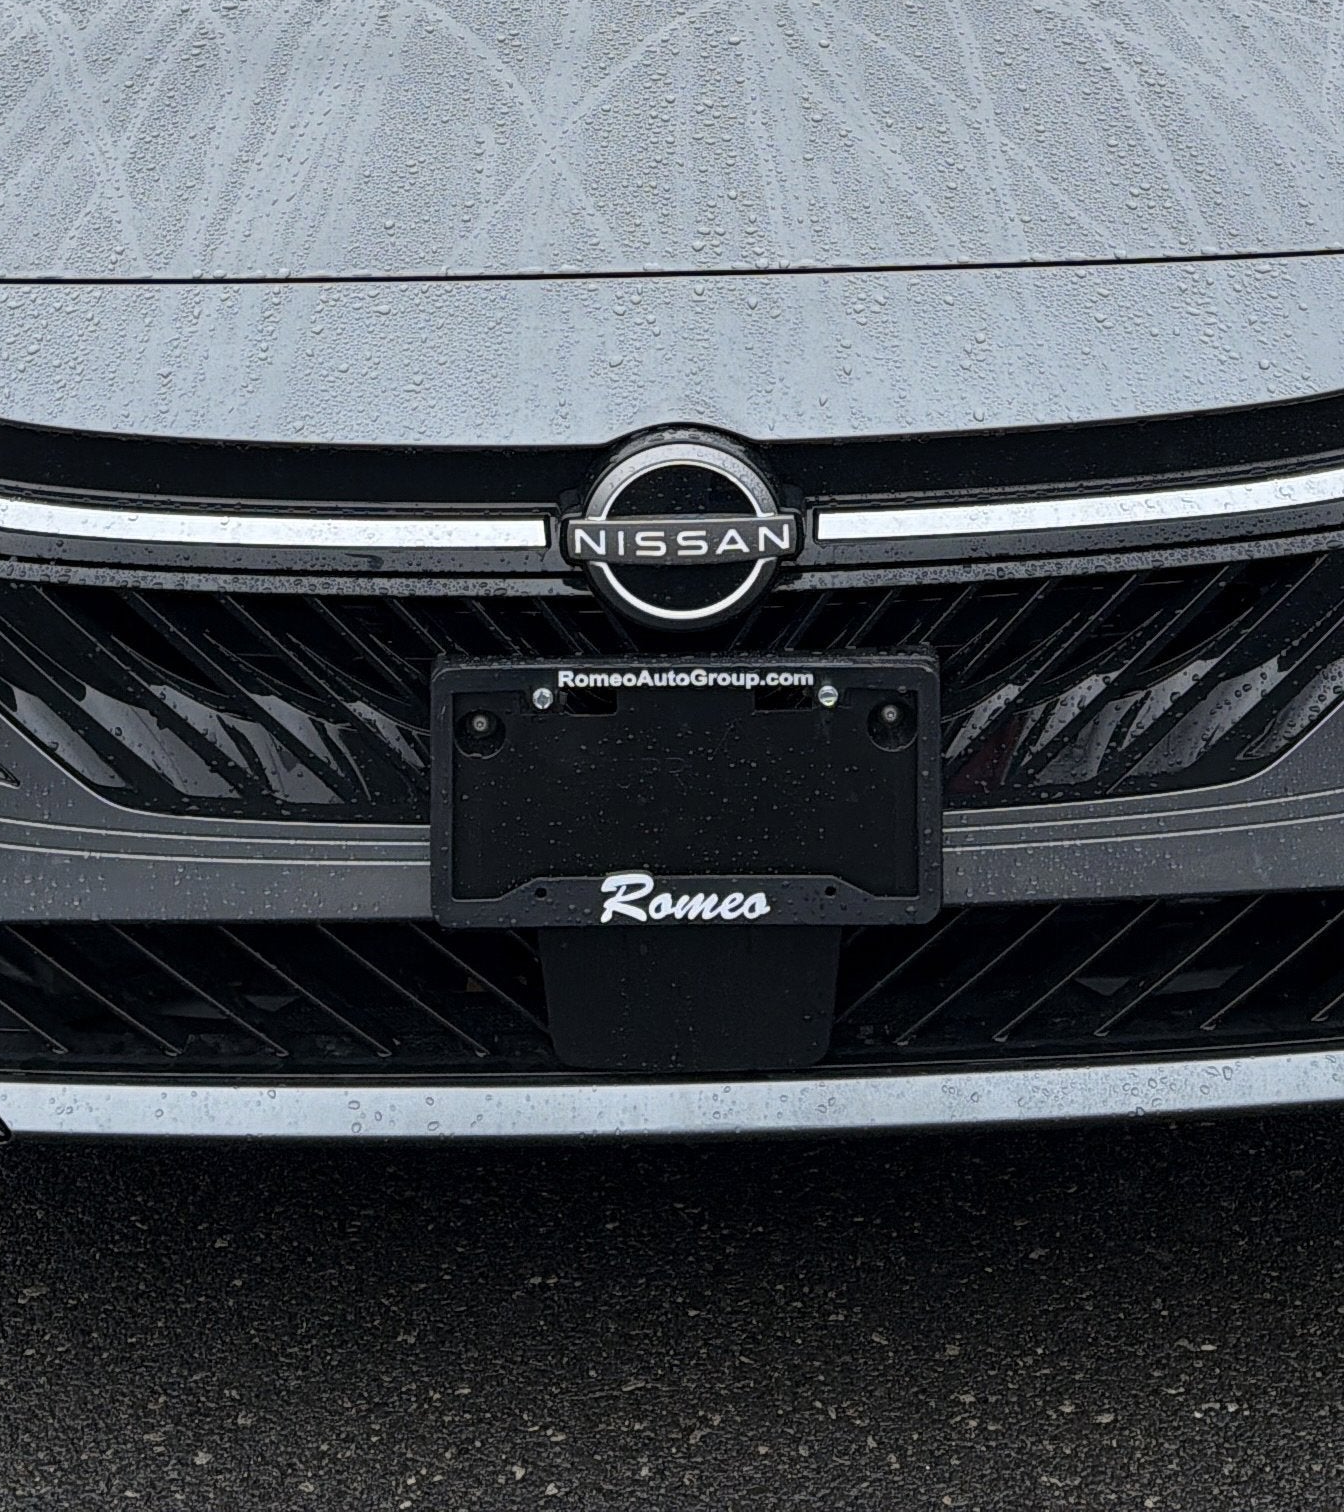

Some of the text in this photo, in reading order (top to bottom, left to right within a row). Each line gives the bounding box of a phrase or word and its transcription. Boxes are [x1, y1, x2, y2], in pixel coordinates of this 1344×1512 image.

[574, 523, 791, 557] NISSAN
[558, 668, 814, 689] RomeoAutoGroup.com
[600, 873, 771, 924] Romeo
